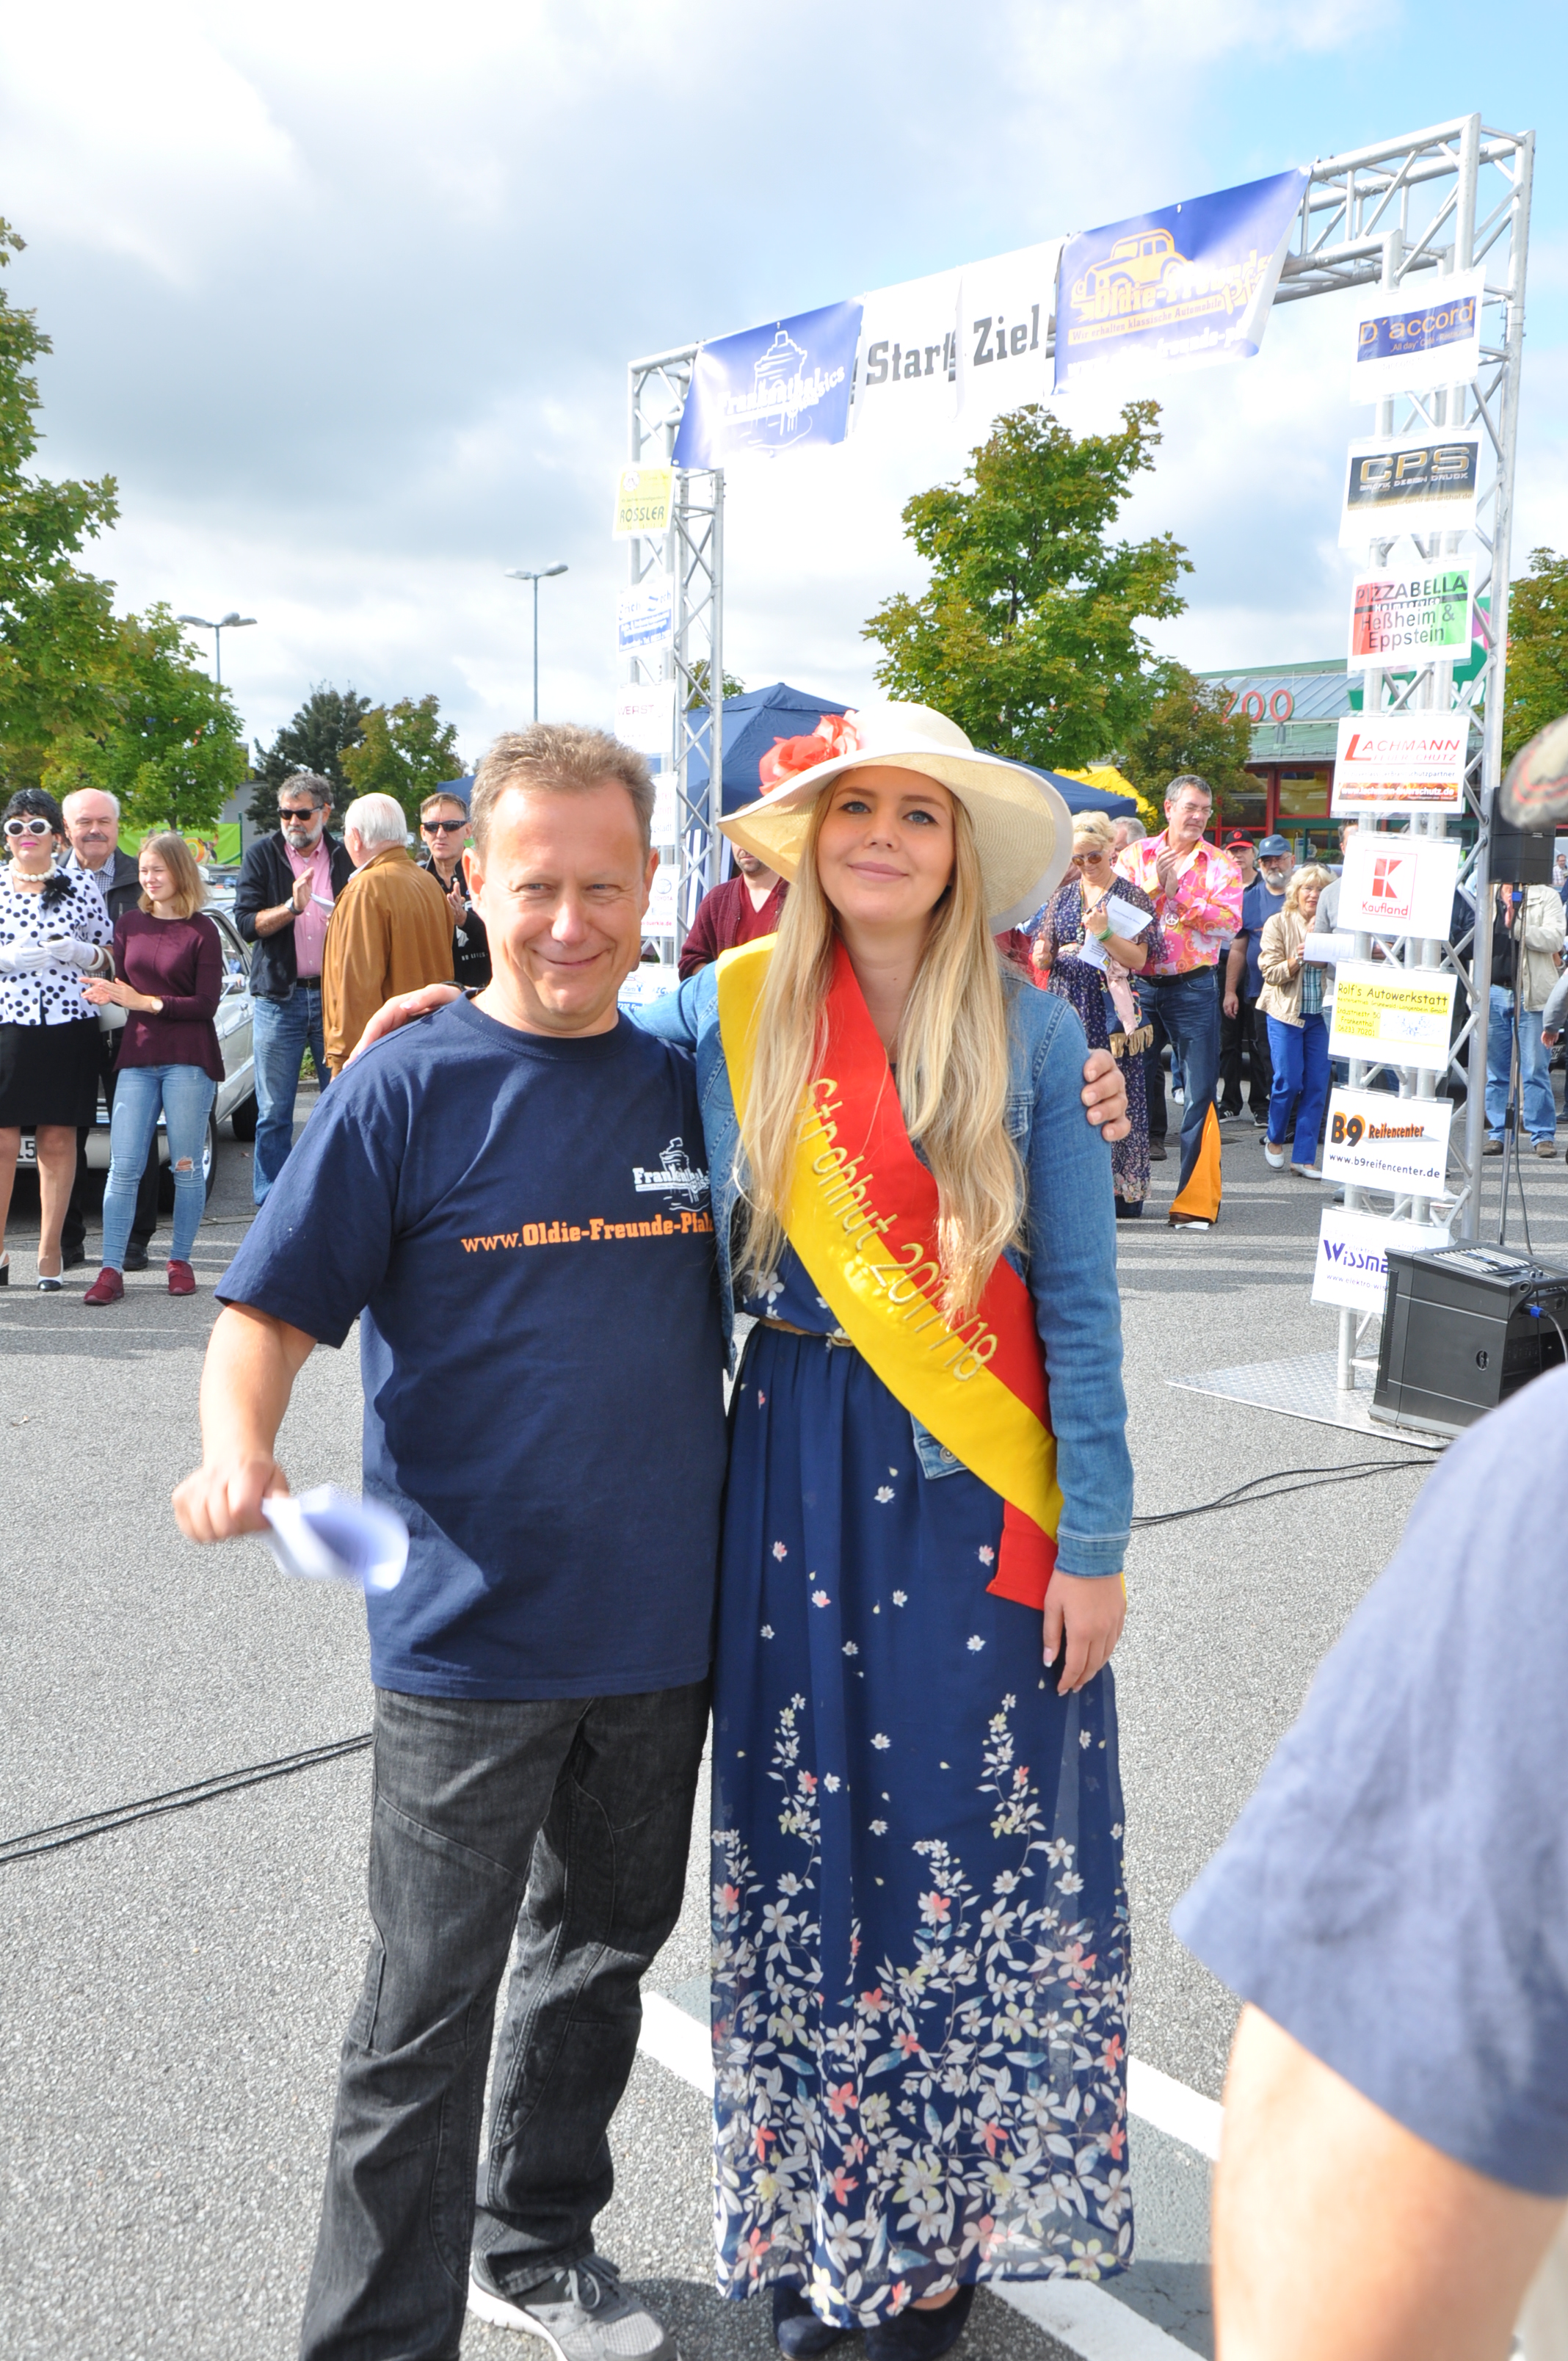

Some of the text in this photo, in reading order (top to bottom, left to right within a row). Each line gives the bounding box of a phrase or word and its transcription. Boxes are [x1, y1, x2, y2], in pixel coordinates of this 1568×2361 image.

[1072, 298, 1222, 341] Wir erhalten klassische Automobile
[973, 303, 1040, 367] Ziel
[1360, 446, 1470, 483] CPS
[620, 505, 665, 523] RÖSSLER
[1361, 603, 1456, 631] Heßheim &
[1374, 598, 1441, 613] Heimservice
[1368, 625, 1445, 653] Eppstein
[1343, 733, 1461, 761] LACHMANN
[1341, 787, 1454, 796] www.lachmann-feuerschutz.de
[1362, 901, 1409, 916] Kaufland
[1337, 982, 1448, 1007] Rolf's Autowerkstatt
[1340, 1016, 1375, 1027] Frankenthal
[1357, 1028, 1376, 1037] 70201
[1330, 1111, 1425, 1147] B9 Reifencenter
[796, 1077, 899, 1252] Strohhut
[1329, 1153, 1441, 1178] www.b9reifencenter.de
[1349, 1244, 1375, 1255] elektro
